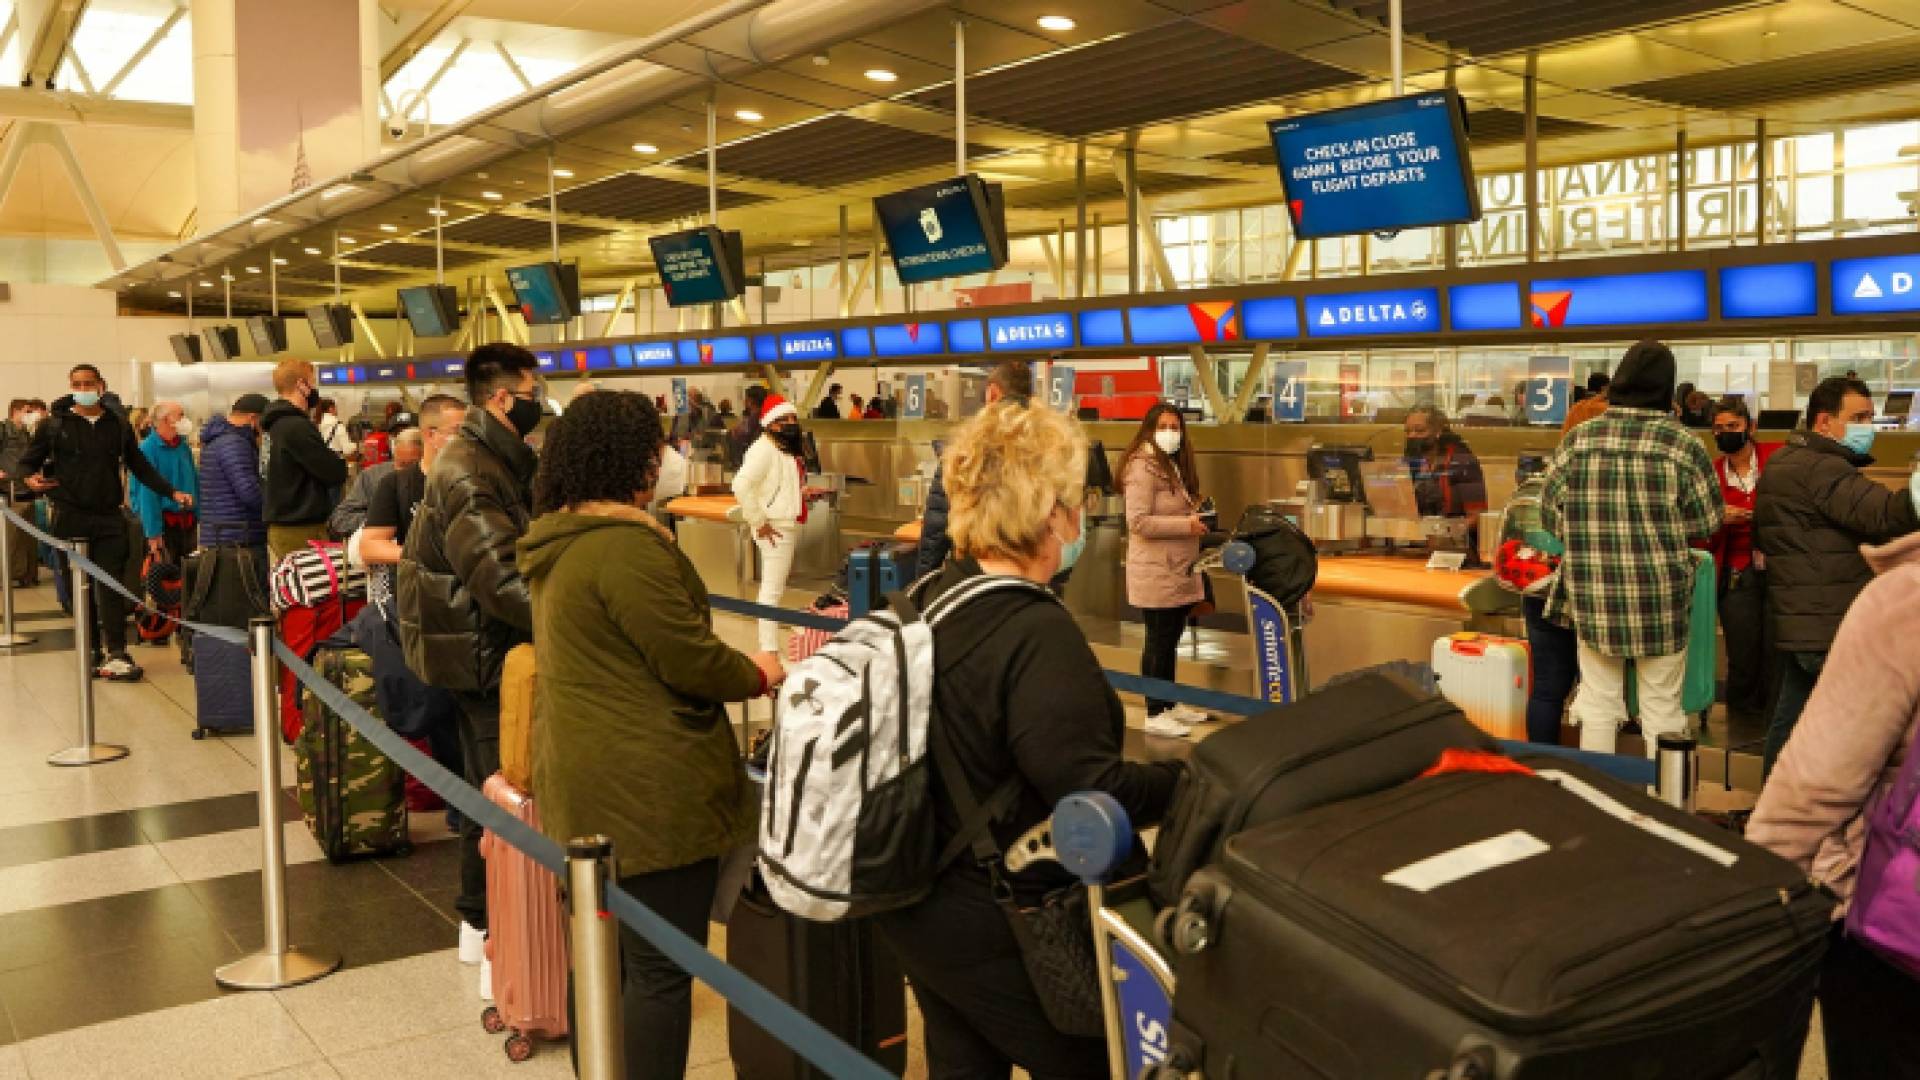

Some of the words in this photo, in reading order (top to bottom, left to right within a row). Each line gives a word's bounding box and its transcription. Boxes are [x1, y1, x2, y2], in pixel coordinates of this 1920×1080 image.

[1304, 140, 1370, 160] CHECK-IN
[1371, 132, 1416, 151] CLOSE
[1341, 154, 1391, 173] BEFORE
[1396, 146, 1440, 164] YOUR
[1312, 175, 1357, 194] FLIGHT
[1361, 167, 1426, 186] DEPARTS
[1338, 303, 1407, 323] DELTA
[1009, 323, 1052, 341] DELTA
[907, 385, 920, 412] 6
[1050, 377, 1062, 406] 5
[1279, 376, 1297, 409] 4
[1533, 372, 1554, 411] 3
